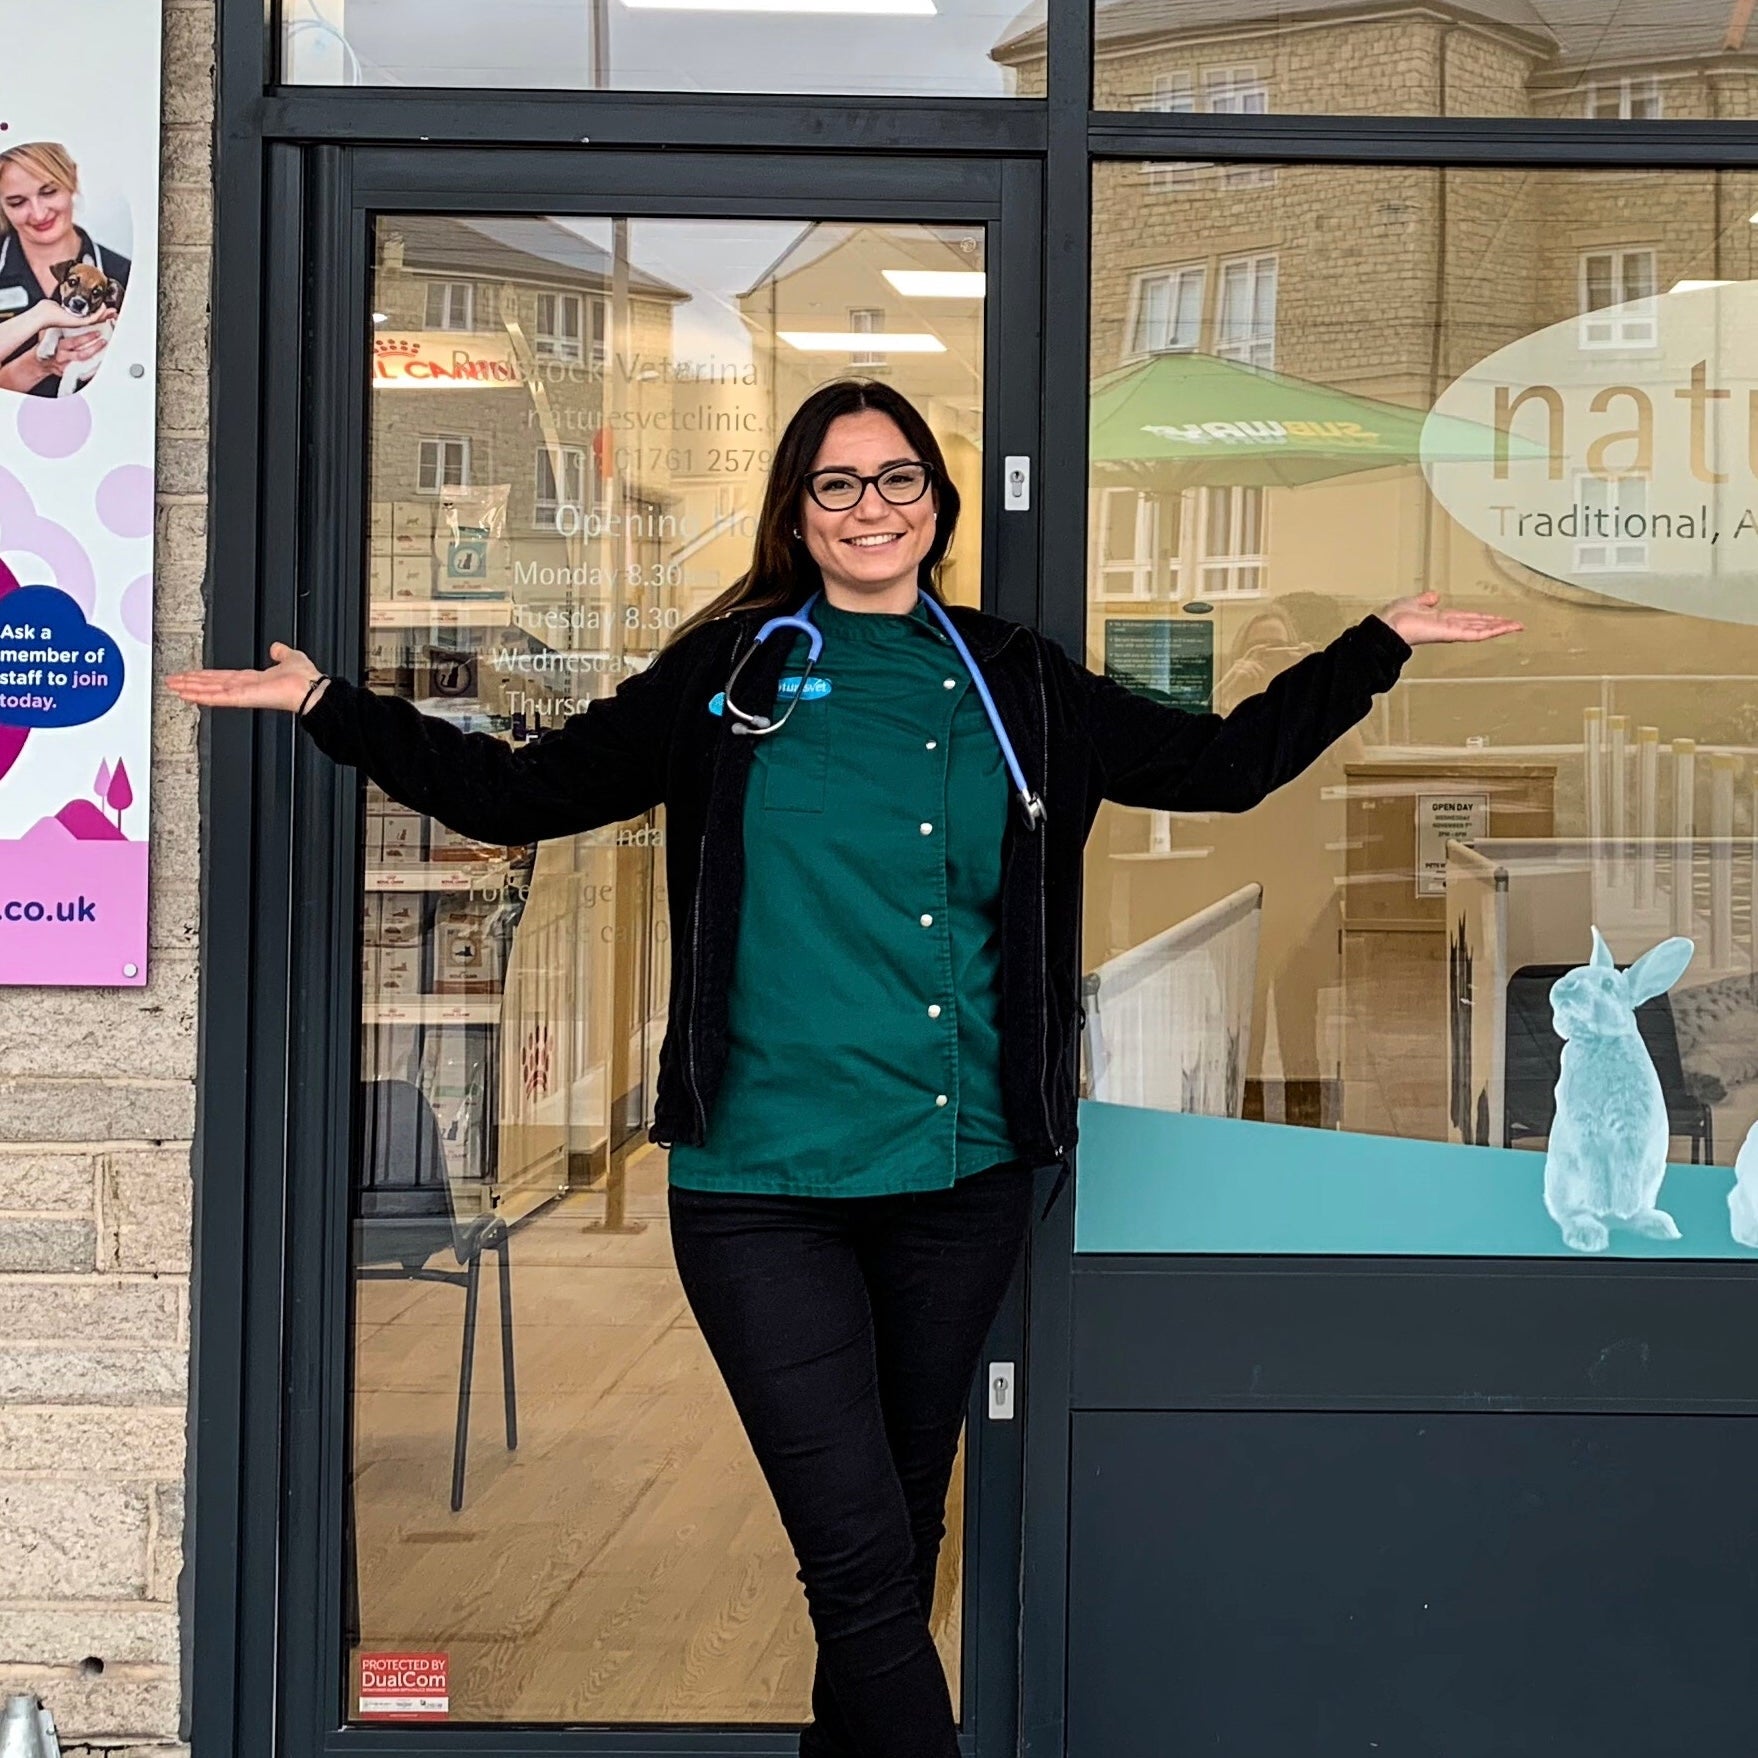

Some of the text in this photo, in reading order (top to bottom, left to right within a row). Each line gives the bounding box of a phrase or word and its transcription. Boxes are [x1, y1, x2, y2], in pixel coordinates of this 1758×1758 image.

[373, 361, 398, 379] L
[616, 353, 759, 386] Veterina
[1493, 359, 1758, 484] nat
[707, 448, 773, 472] 2579
[1488, 504, 1719, 544] Traditional,
[513, 560, 617, 590] Monday
[513, 604, 680, 634] Tuesday 8.30
[0, 624, 52, 640] Ask a
[0, 646, 105, 663] member of
[492, 648, 633, 677] Wednesday
[0, 669, 108, 689] staff to join
[0, 693, 56, 712] today.
[505, 690, 591, 716] Thursd
[1432, 803, 1473, 811] OPEN DAY
[618, 822, 664, 847] nda
[362, 1659, 445, 1671] PROTECTED BY
[362, 1671, 446, 1687] DualCom
